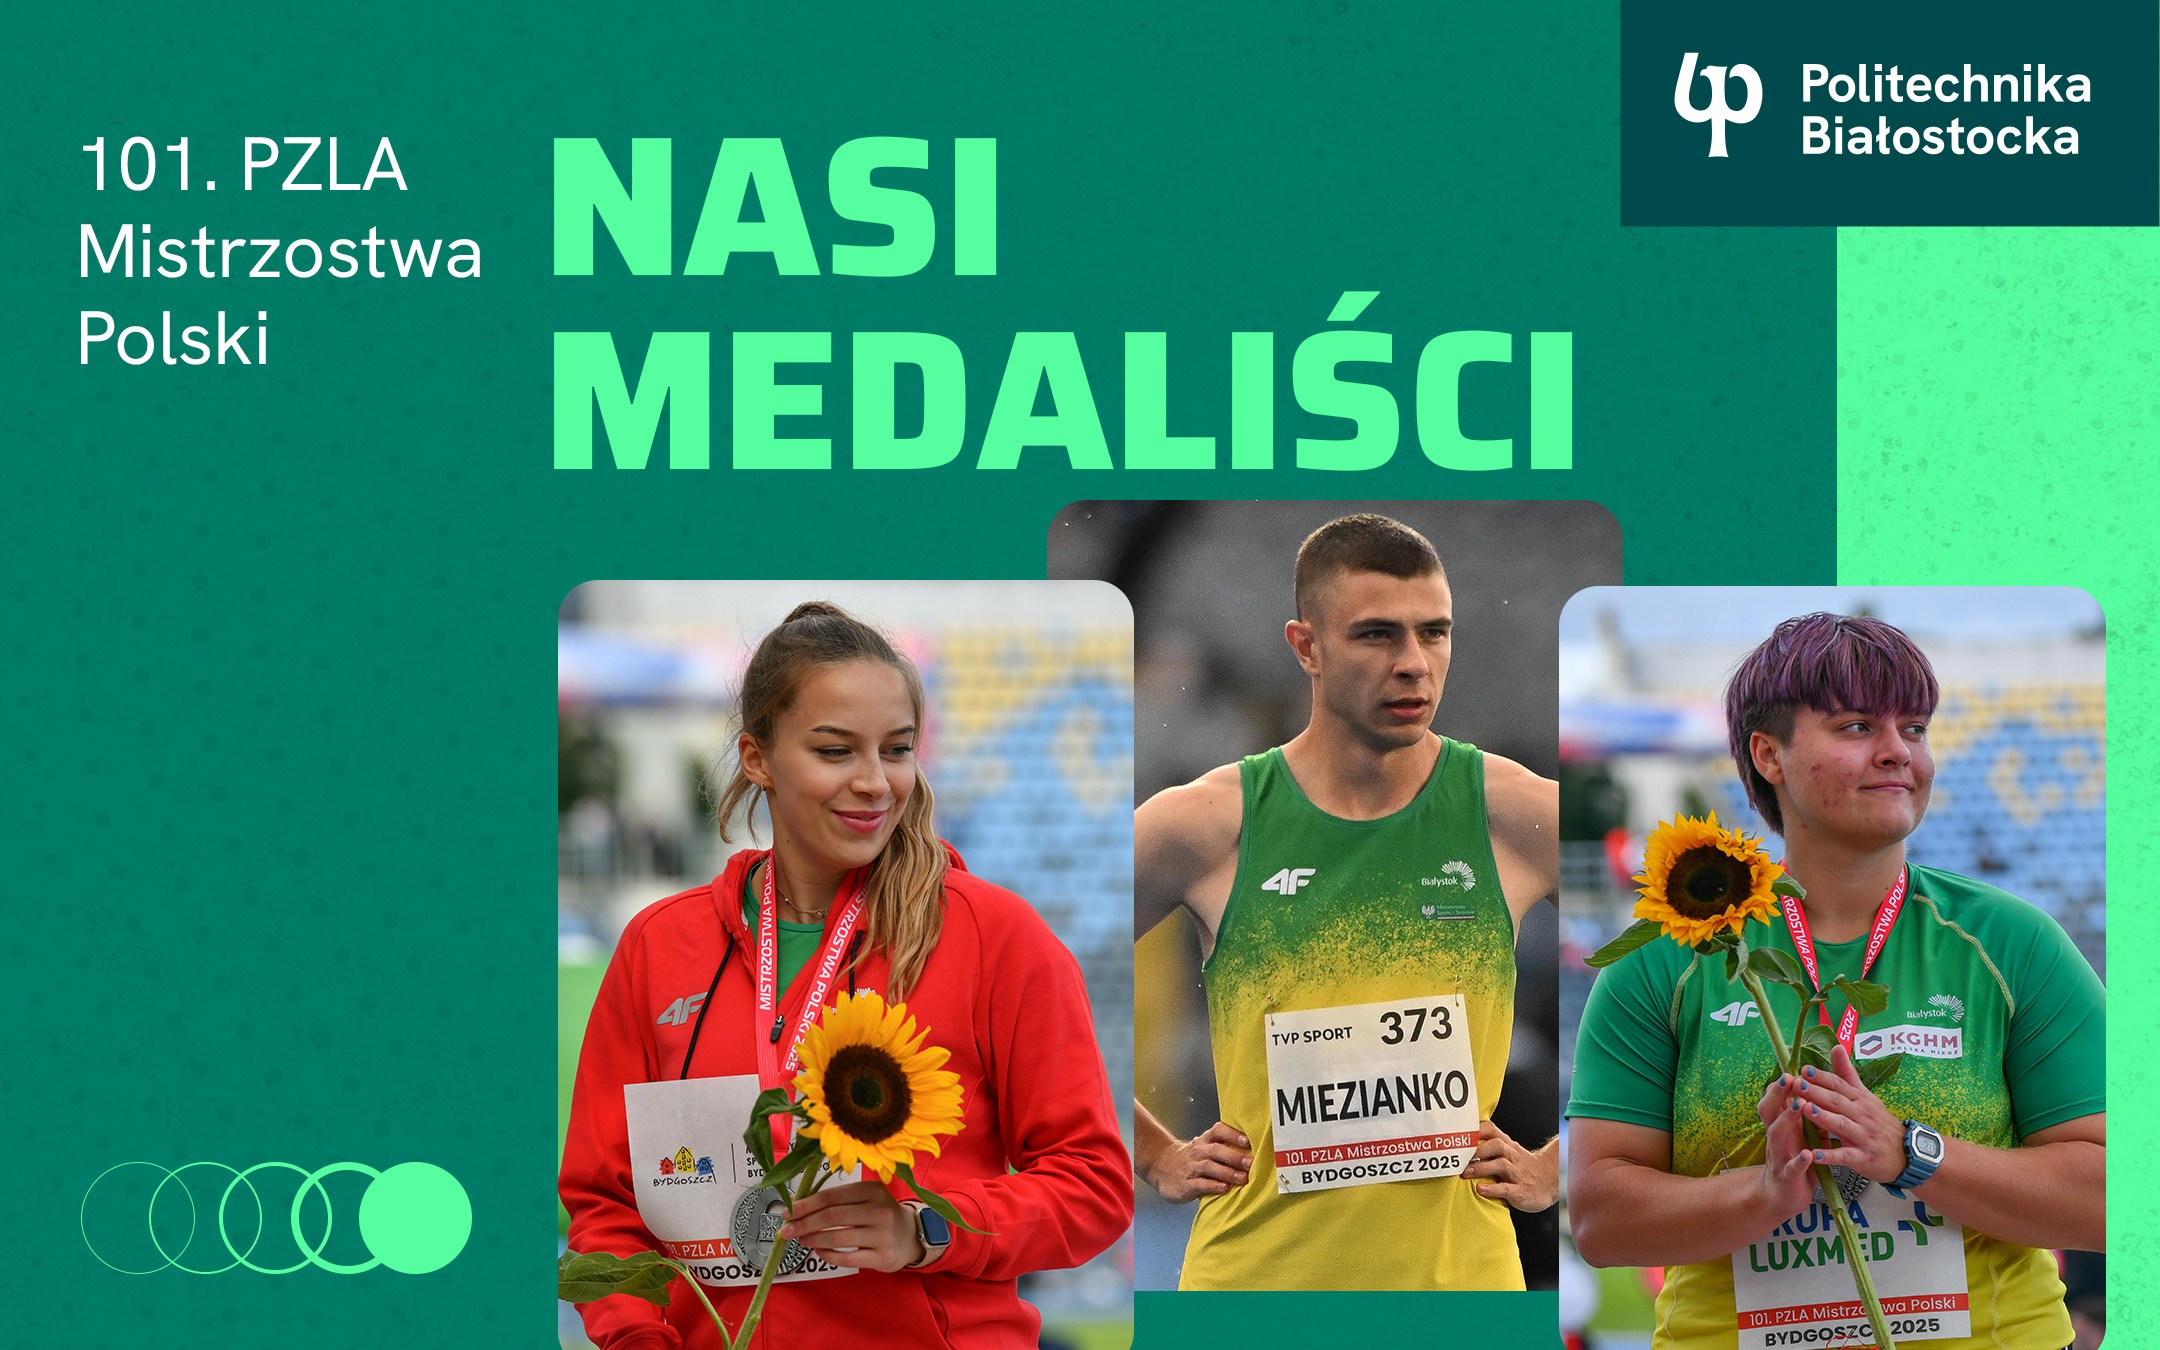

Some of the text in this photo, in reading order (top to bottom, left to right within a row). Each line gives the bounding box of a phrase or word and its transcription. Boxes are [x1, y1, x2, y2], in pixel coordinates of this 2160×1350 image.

[1261, 868, 1316, 895] 4F
[1783, 895, 1811, 954] RZOSTWA
[759, 908, 773, 1011] MISTRZOSTWA
[656, 991, 709, 1027] 4F
[798, 980, 827, 1033] POLSKI
[1709, 1001, 1761, 1027] 4F
[1272, 1026, 1353, 1046] TVP SPORT
[1379, 1006, 1453, 1045] 373
[1840, 1010, 1855, 1042] 2025
[1890, 1031, 1958, 1048] KGHM
[1276, 1070, 1470, 1126] MIEZIANKO
[1285, 1133, 1472, 1165] 101. PZLA Mistrzostwa Polski
[652, 1175, 713, 1187] BYDGOSZCZ
[1301, 1154, 1460, 1184] BYDGOSZCZ 2025
[681, 1243, 716, 1257] PZLA
[688, 1264, 762, 1280] YDGOS
[1749, 1296, 1956, 1326] 101. PZLA Mistrzowa Polski
[1765, 1318, 1941, 1347] BYDGOSZC 2025
